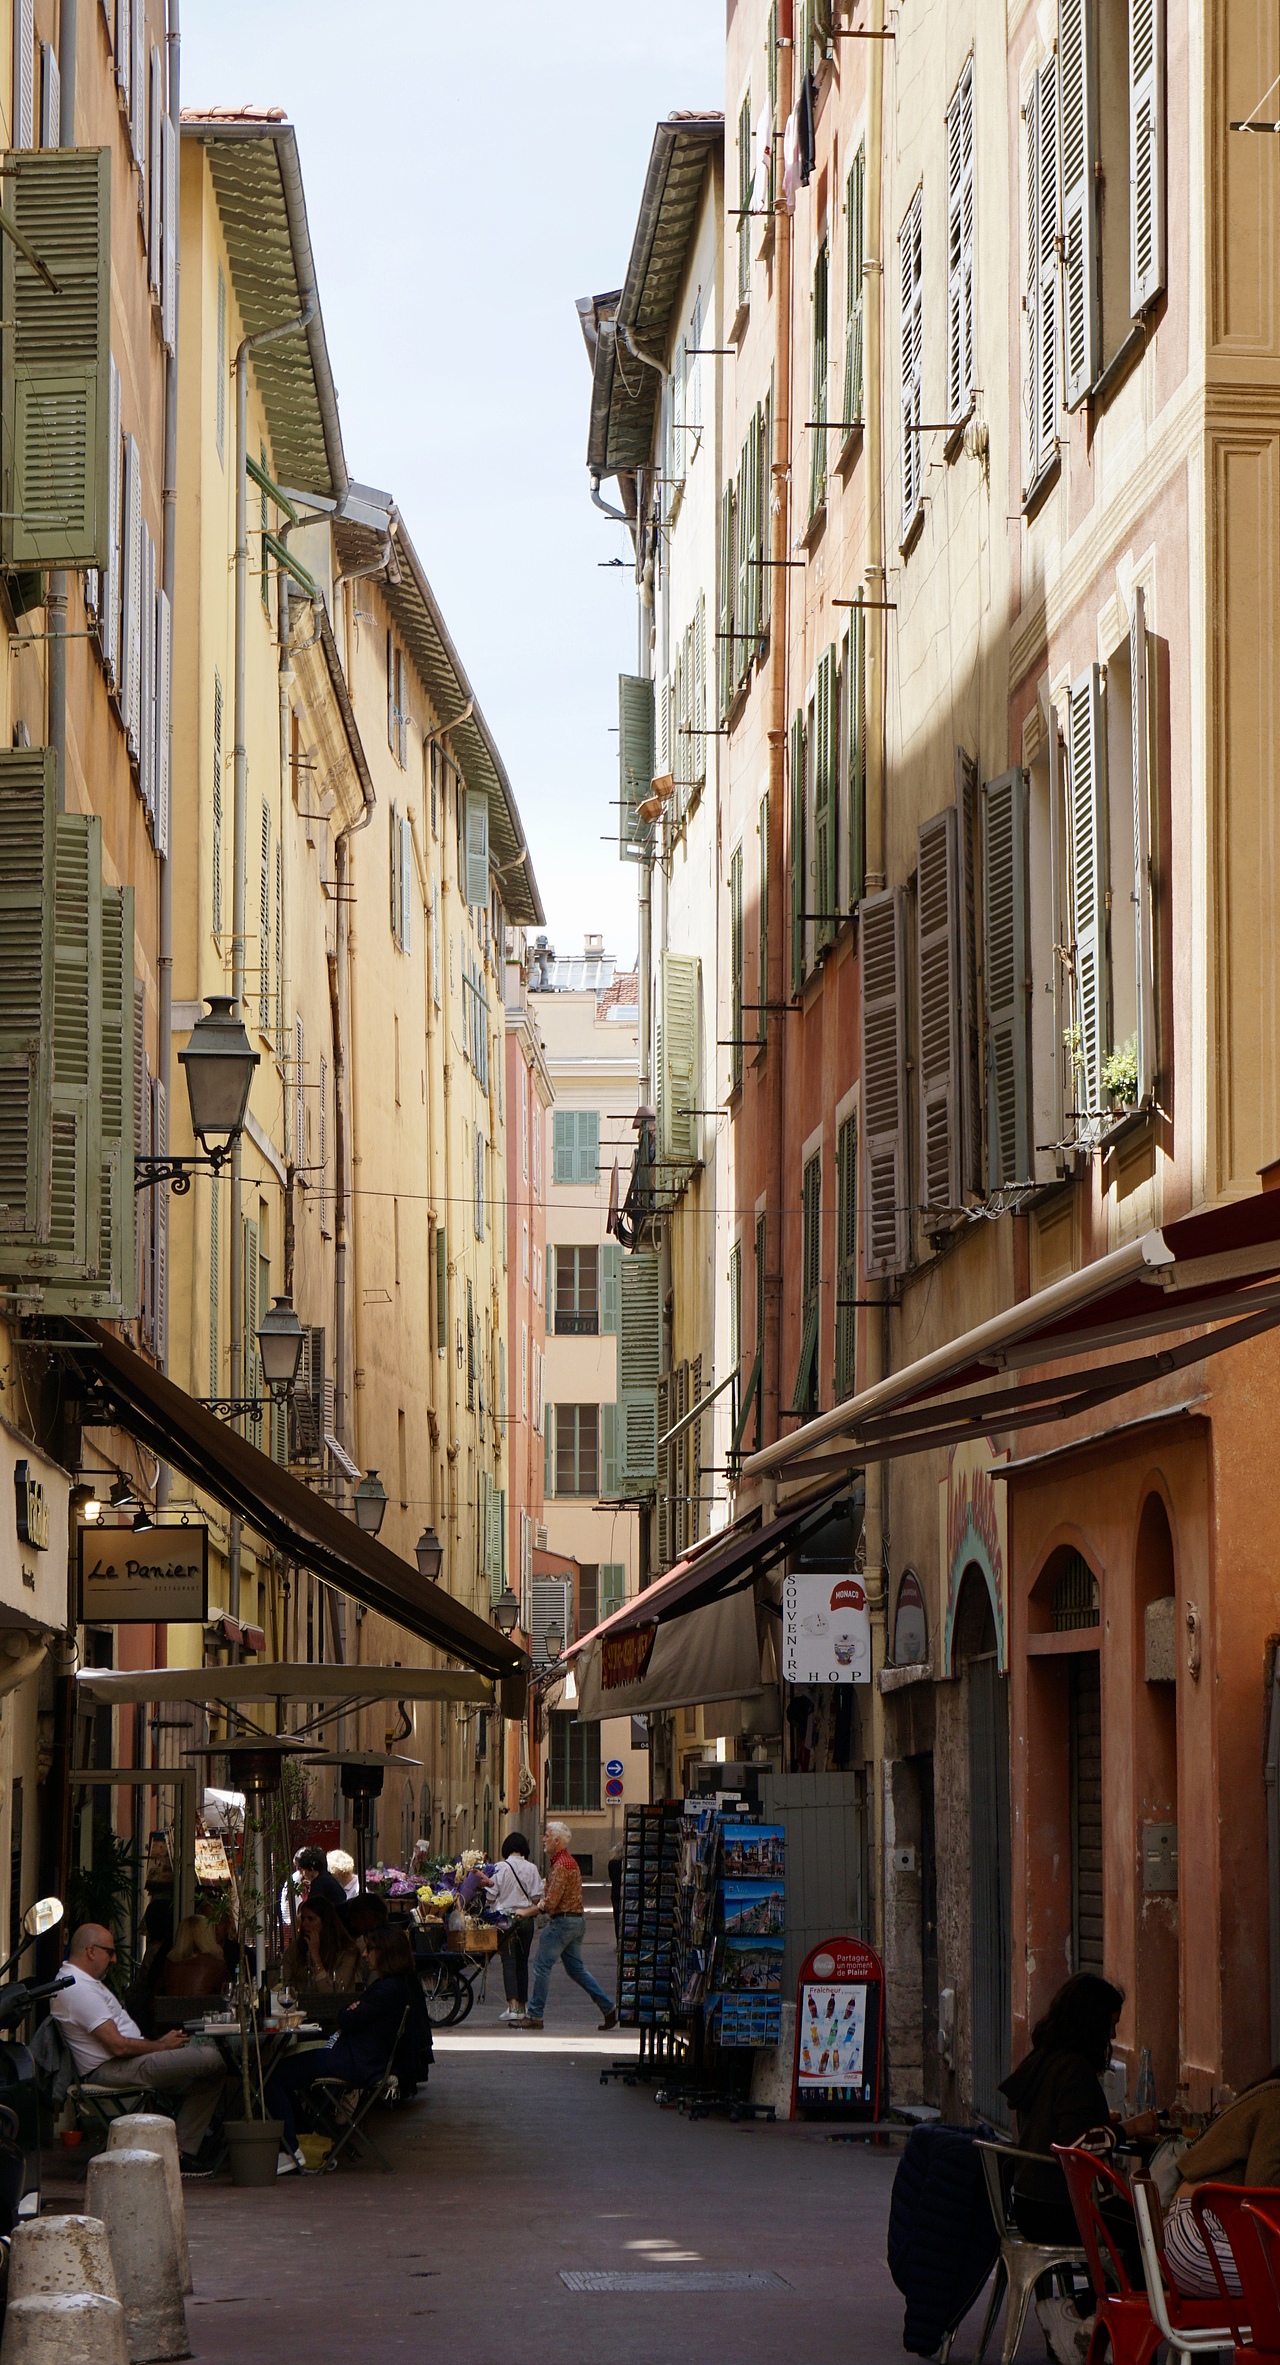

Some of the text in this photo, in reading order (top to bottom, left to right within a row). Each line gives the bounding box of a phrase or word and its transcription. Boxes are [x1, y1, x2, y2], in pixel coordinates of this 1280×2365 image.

[88, 1559, 200, 1579] Le Panier
[835, 1590, 859, 1599] MONACO
[786, 1575, 798, 1682] SOUVENIRS
[836, 1954, 869, 1963] Partagez
[836, 1969, 846, 1977] de
